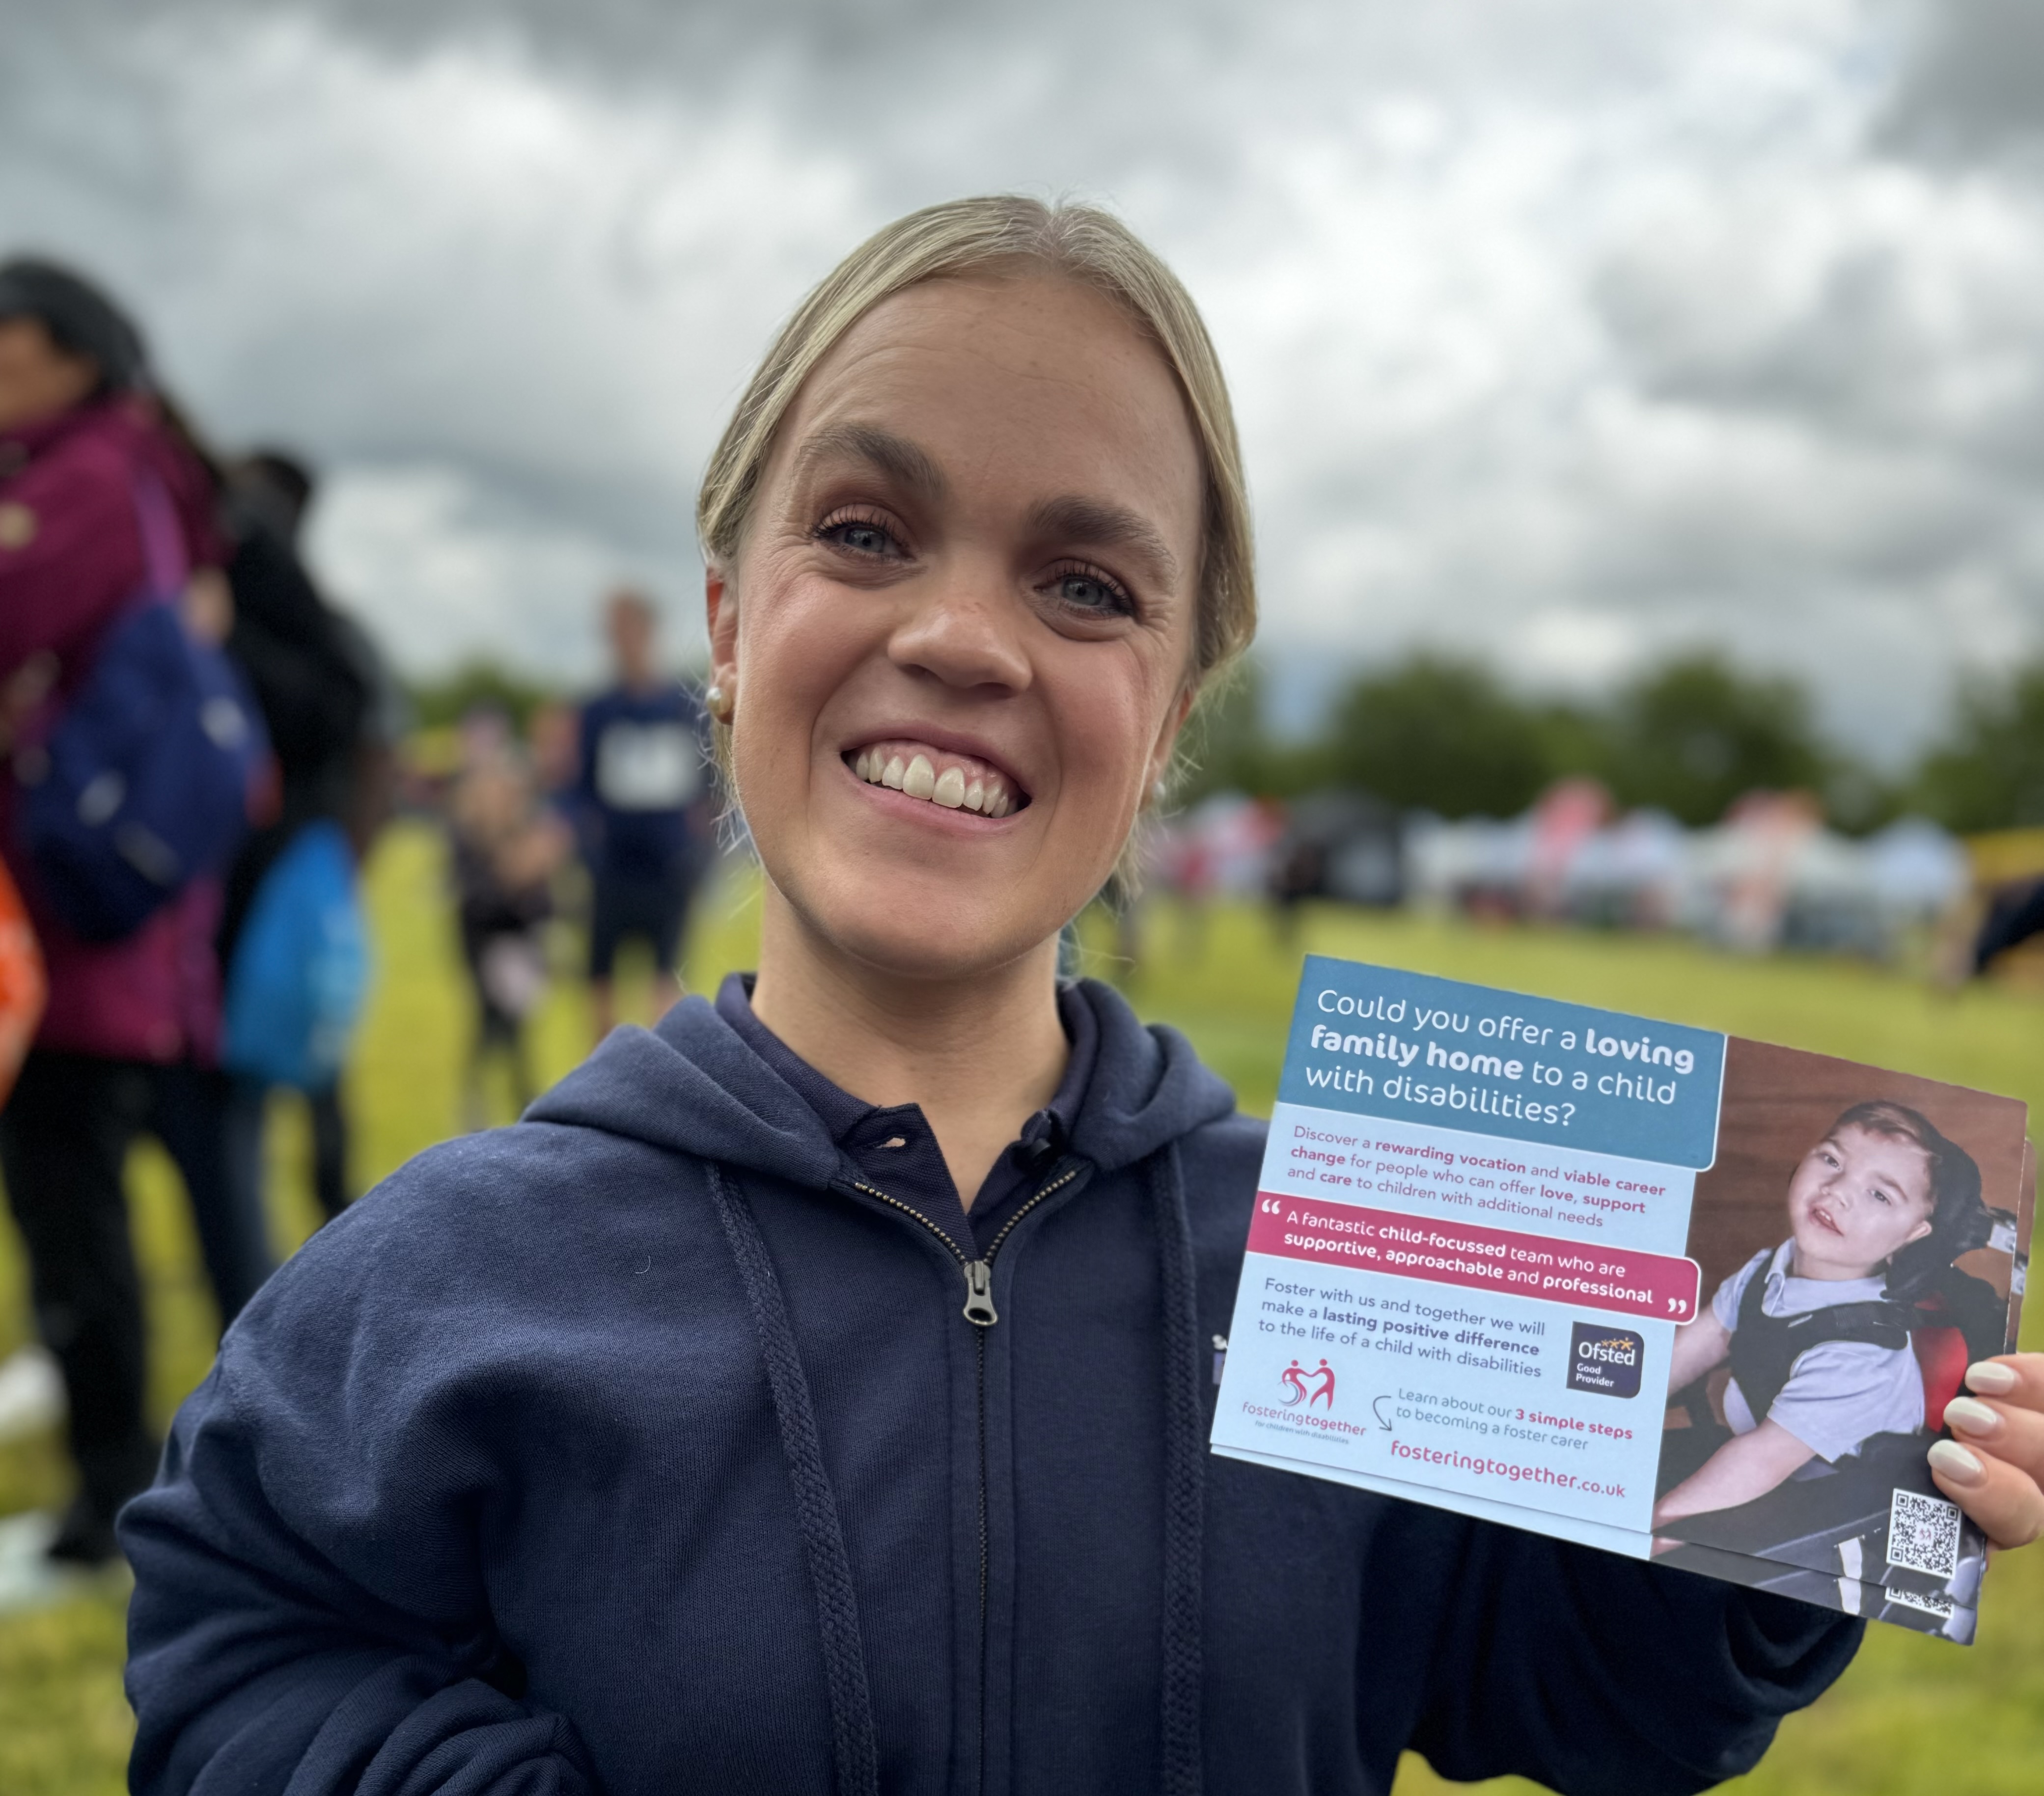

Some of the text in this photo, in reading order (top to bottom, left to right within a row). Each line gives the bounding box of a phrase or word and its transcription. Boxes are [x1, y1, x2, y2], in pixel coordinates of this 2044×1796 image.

[1318, 989, 1694, 1074] Could you offer a loving
[1311, 1024, 1676, 1104] family home to a child
[1306, 1065, 1575, 1126] with disabilities?
[1291, 1145, 1646, 1214] change for people who can offer love, support
[1294, 1125, 1666, 1196] Discover a rewarding vocation and viable career
[1288, 1168, 1603, 1227] and care to children with additional needs
[1284, 1233, 1381, 1261] supportive,
[1385, 1250, 1503, 1279] approachable
[1507, 1270, 1539, 1284] and
[1543, 1276, 1653, 1304] professional
[1287, 1211, 1298, 1224] A
[1302, 1212, 1375, 1236] fantastic
[1379, 1226, 1506, 1257] child-focussed
[1511, 1248, 1553, 1265] team
[1558, 1256, 1594, 1272] who
[1599, 1263, 1625, 1277] are
[1262, 1301, 1540, 1356] make a lasting positive difference
[1265, 1278, 1545, 1336] Foster with us and together we will
[1259, 1320, 1541, 1377] to the life of a child with disabilities
[1576, 1363, 1601, 1374] Good
[1578, 1341, 1636, 1366] Ofsted
[1575, 1373, 1614, 1387] Provider
[1266, 1421, 1294, 1433] children
[1311, 1431, 1349, 1444] disabilities
[1396, 1406, 1588, 1450] to becoming a foster carer
[1399, 1388, 1632, 1440] Learn about our 3 simple steps
[1391, 1440, 1625, 1497] fosteringtogether.co.uk
